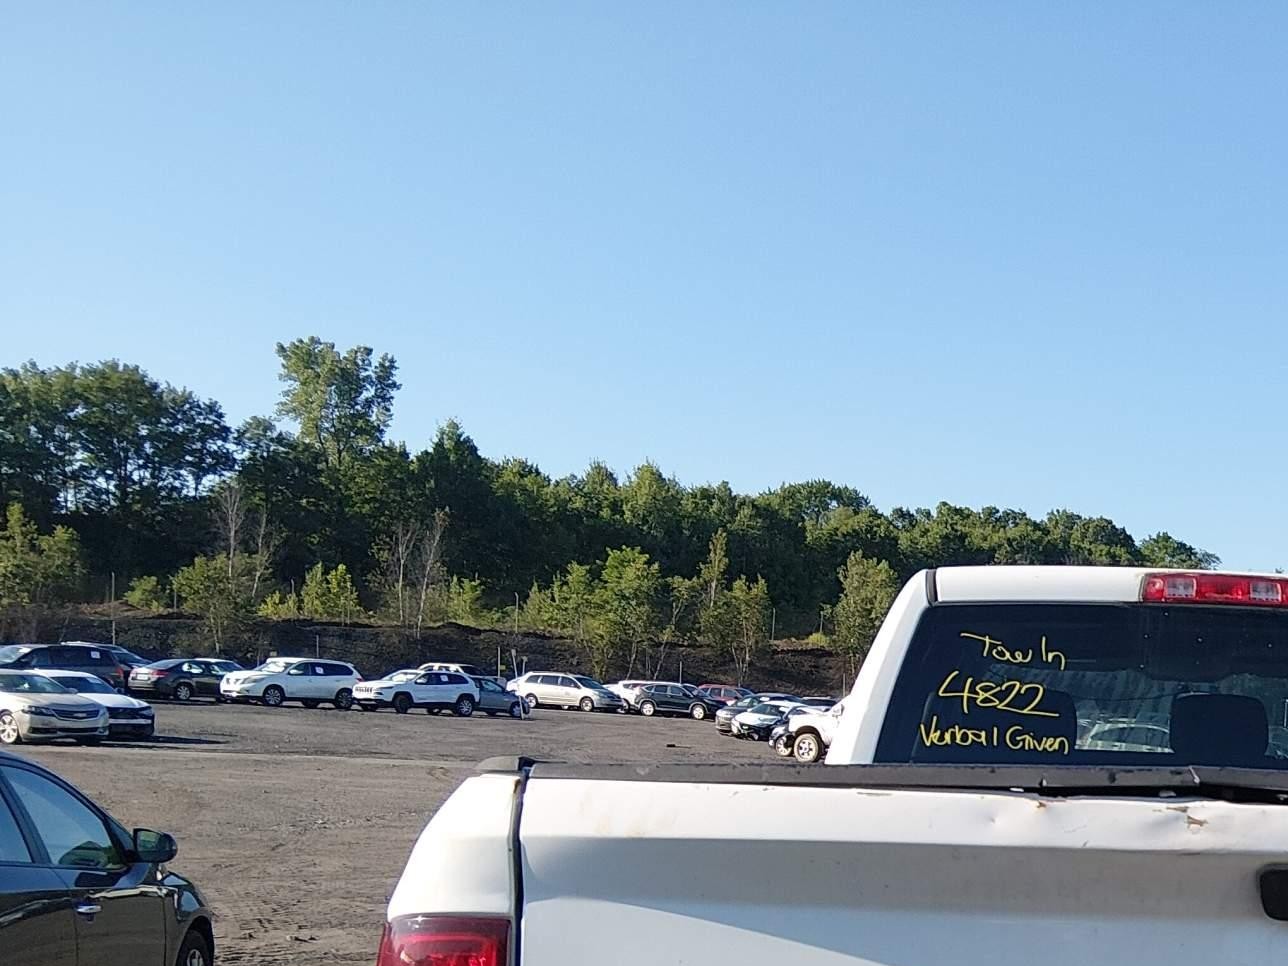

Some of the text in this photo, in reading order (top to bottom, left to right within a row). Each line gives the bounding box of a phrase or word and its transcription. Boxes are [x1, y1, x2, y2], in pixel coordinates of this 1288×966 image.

[960, 632, 1066, 671] Tow In
[938, 670, 1060, 717] 4822
[919, 715, 1069, 755] Verbal Given
